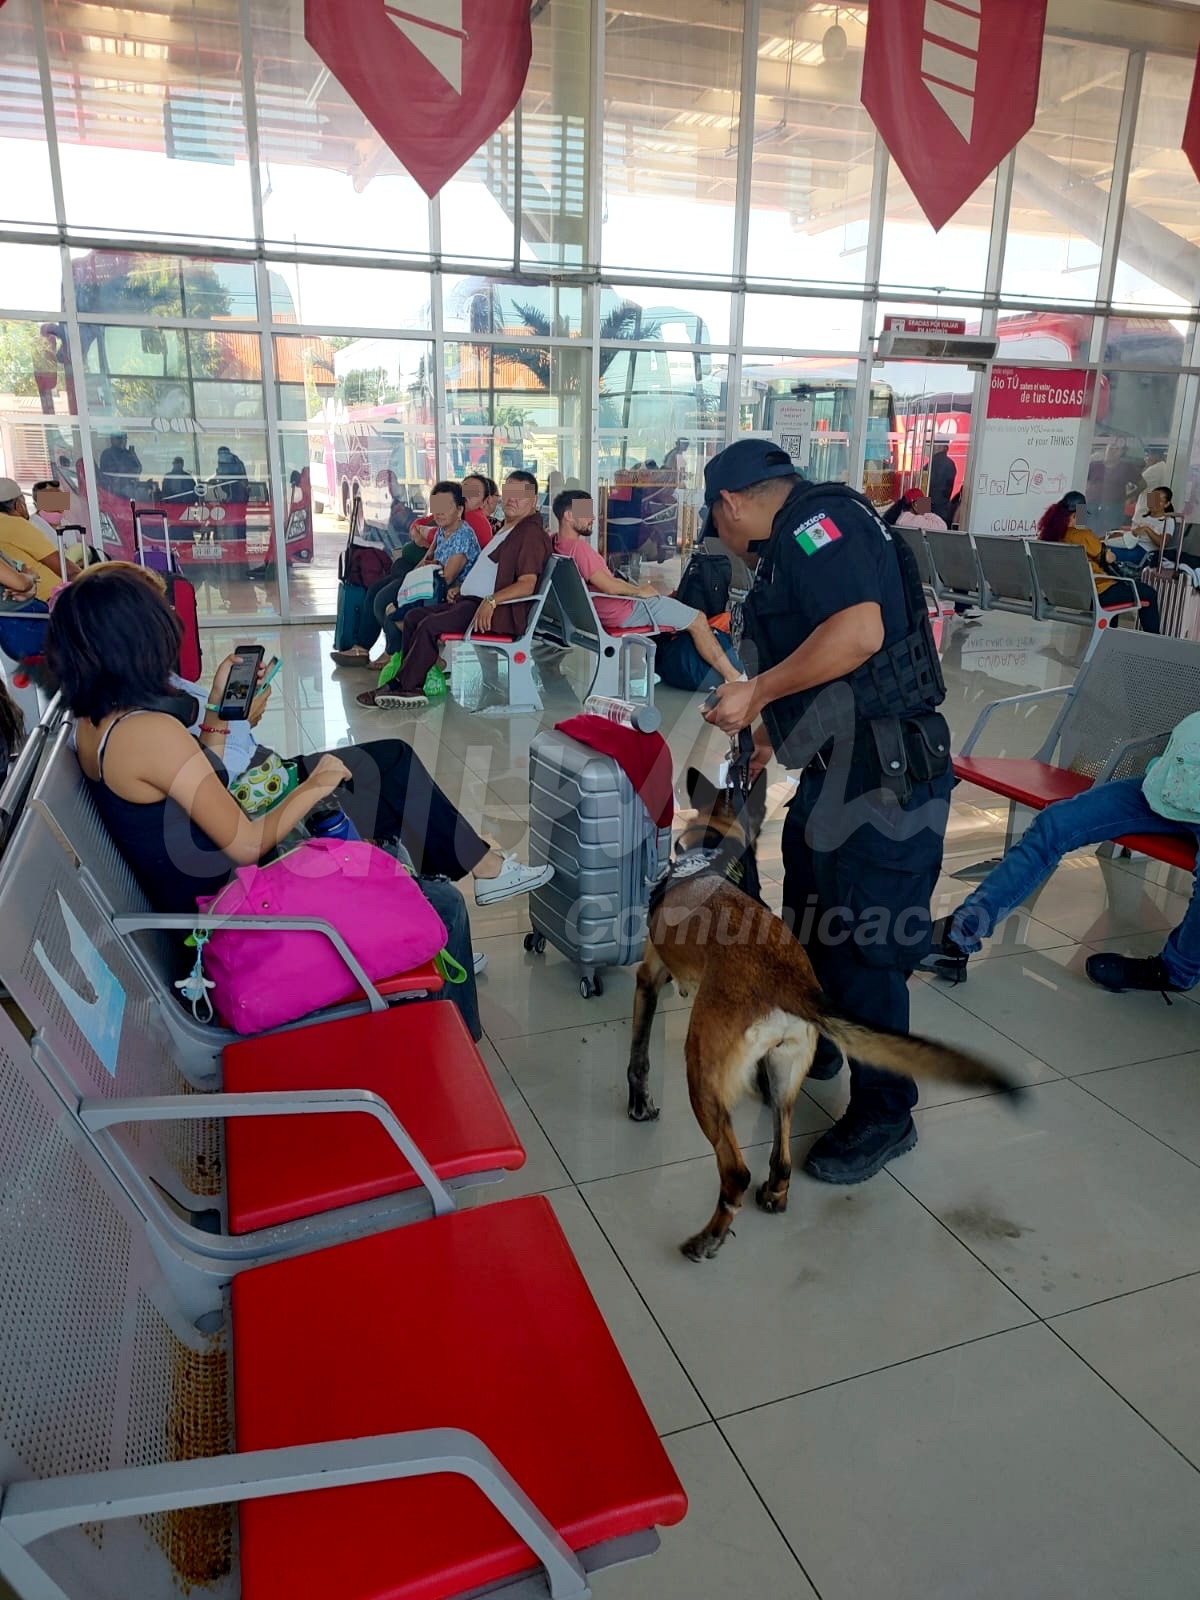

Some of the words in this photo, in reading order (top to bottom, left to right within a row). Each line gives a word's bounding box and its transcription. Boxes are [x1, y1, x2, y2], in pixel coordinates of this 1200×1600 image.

[1007, 374, 1019, 390] TÚ
[1021, 390, 1030, 403] de
[1033, 392, 1046, 404] tus
[1048, 389, 1084, 405] COSAS
[1050, 436, 1075, 447] THINGS
